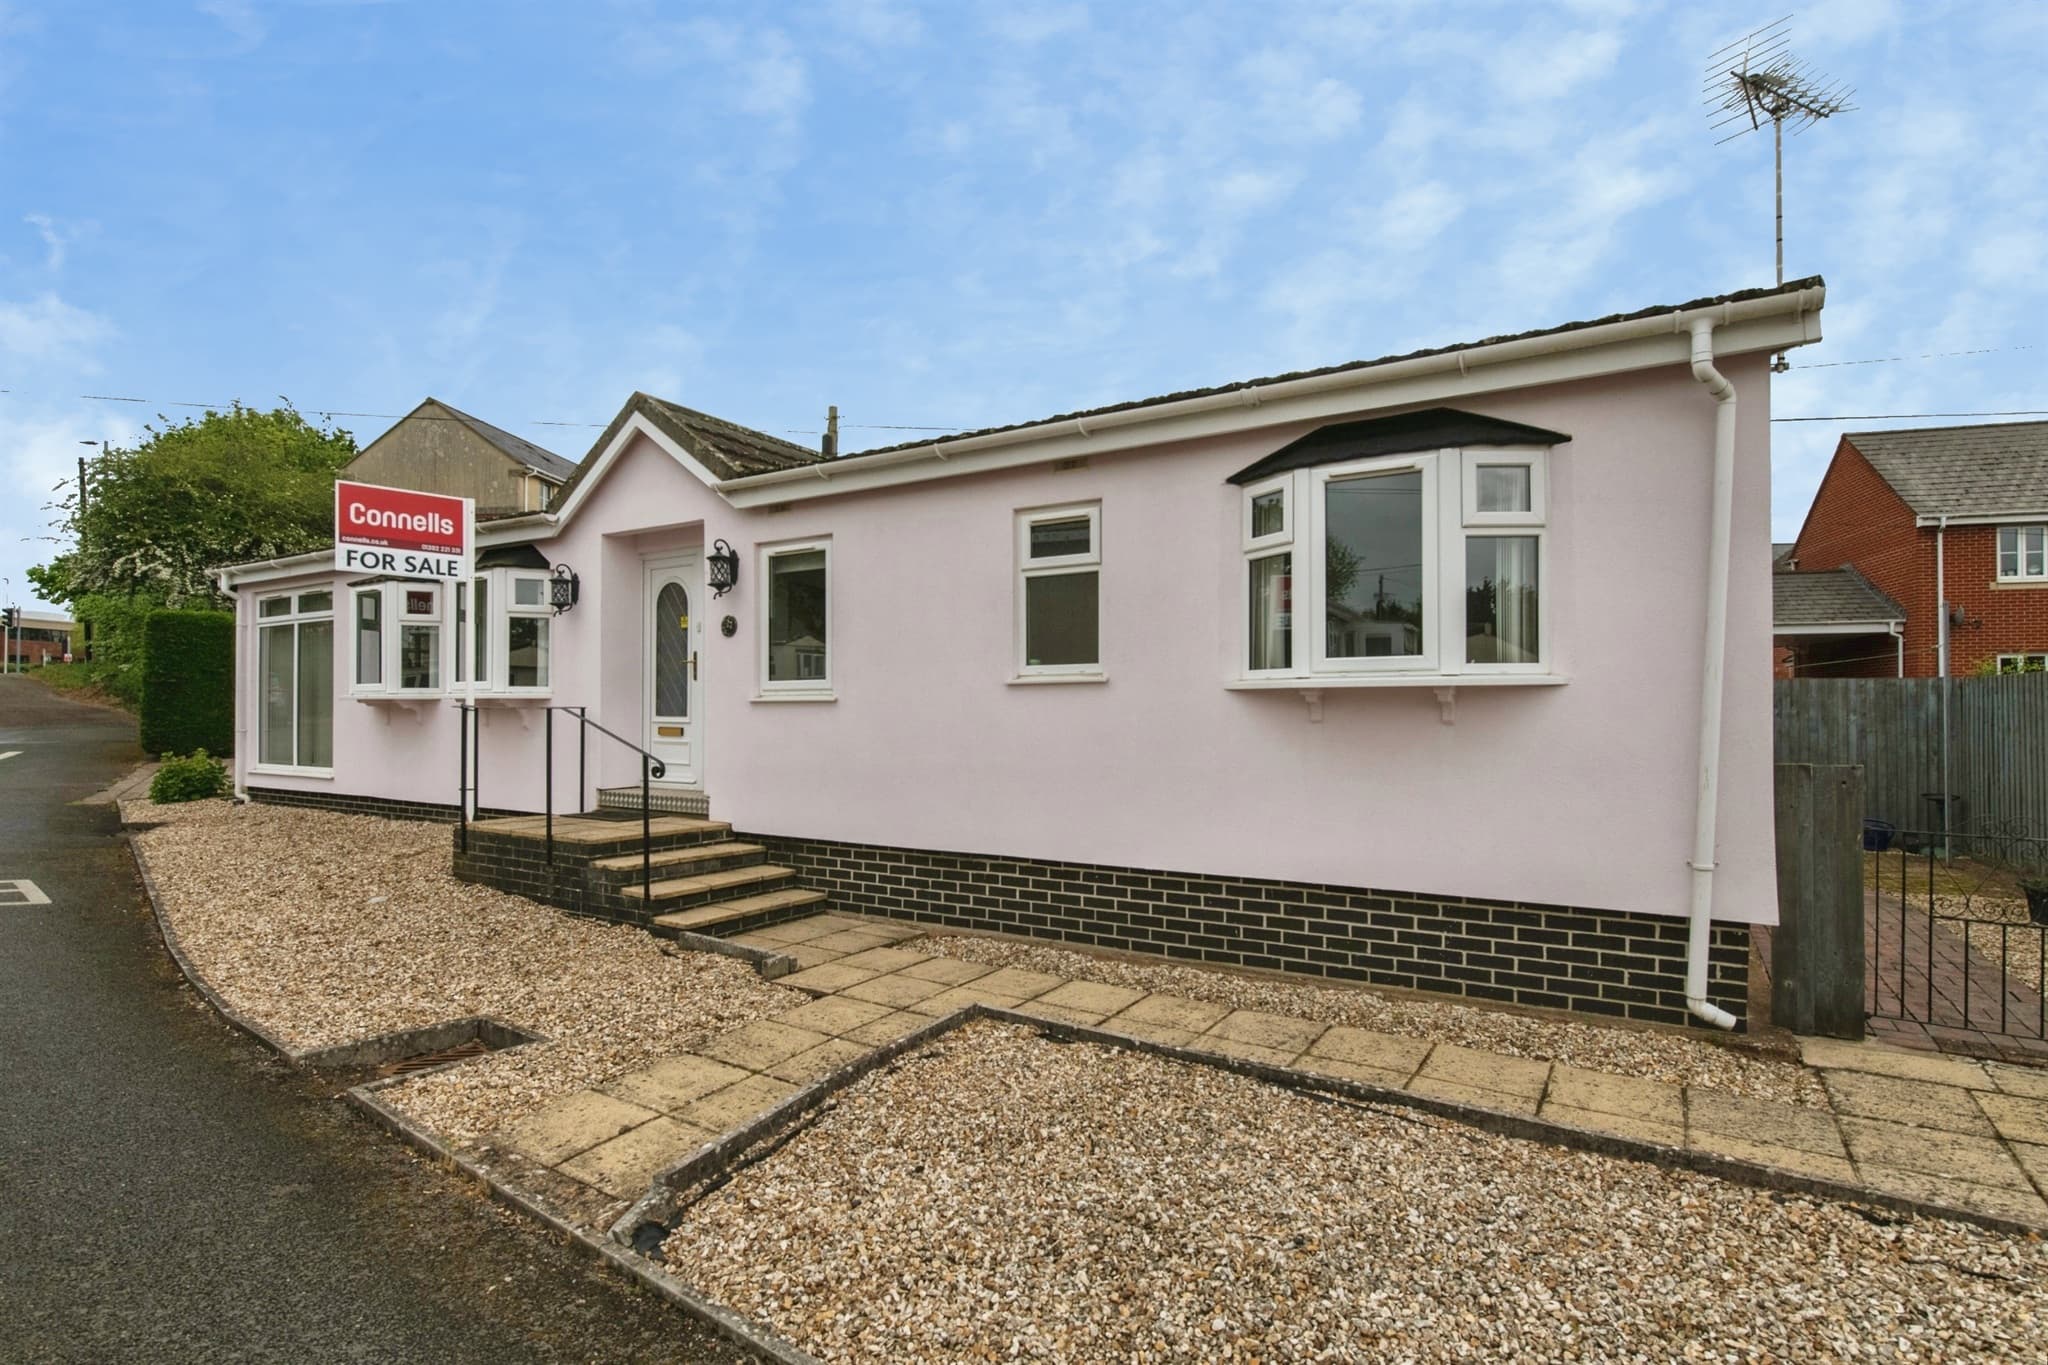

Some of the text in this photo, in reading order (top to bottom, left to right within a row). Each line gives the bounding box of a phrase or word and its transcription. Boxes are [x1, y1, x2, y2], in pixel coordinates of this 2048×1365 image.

[349, 502, 454, 535] Connells
[341, 535, 389, 546] connells.co.uk
[346, 549, 459, 577] FOR SALE
